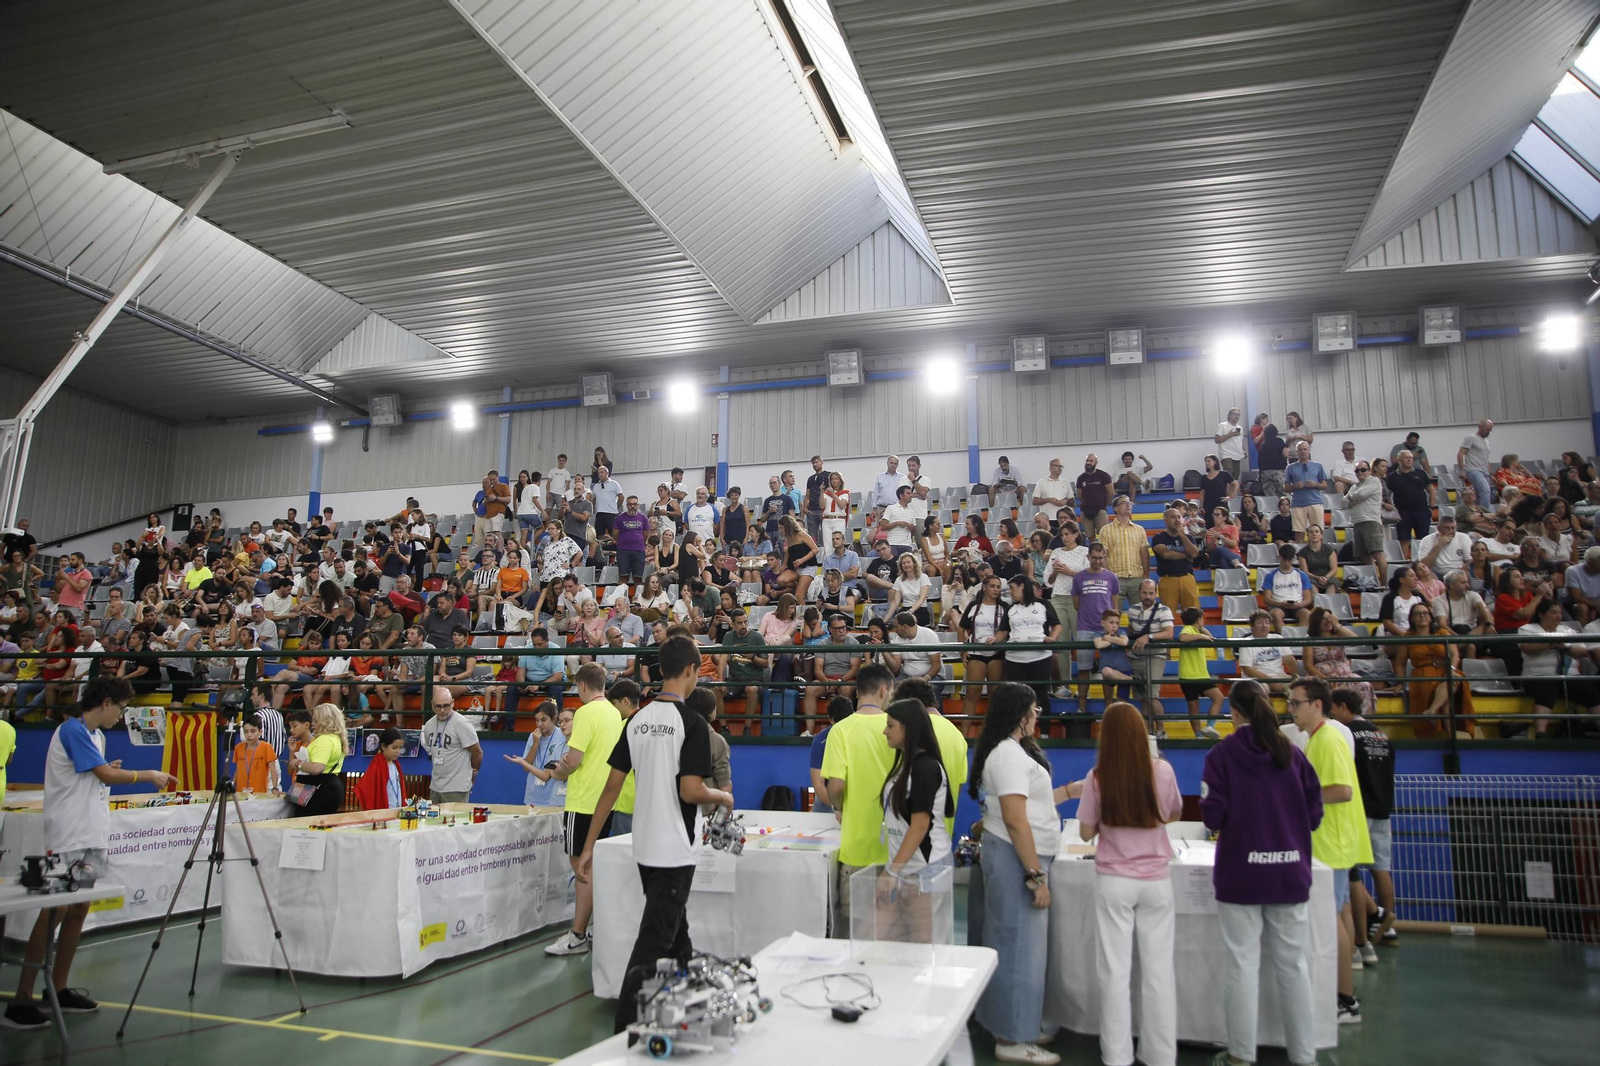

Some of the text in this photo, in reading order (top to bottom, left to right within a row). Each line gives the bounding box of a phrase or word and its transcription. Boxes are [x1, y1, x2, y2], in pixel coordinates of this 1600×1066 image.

[428, 732, 452, 750] GAP
[122, 827, 165, 840] sociedad
[107, 836, 211, 856] ualdad entre hombrs y
[428, 855, 443, 866] una
[445, 847, 477, 863] sociedad
[422, 867, 460, 885] igualdad
[460, 865, 479, 876] entre
[506, 857, 512, 868] y
